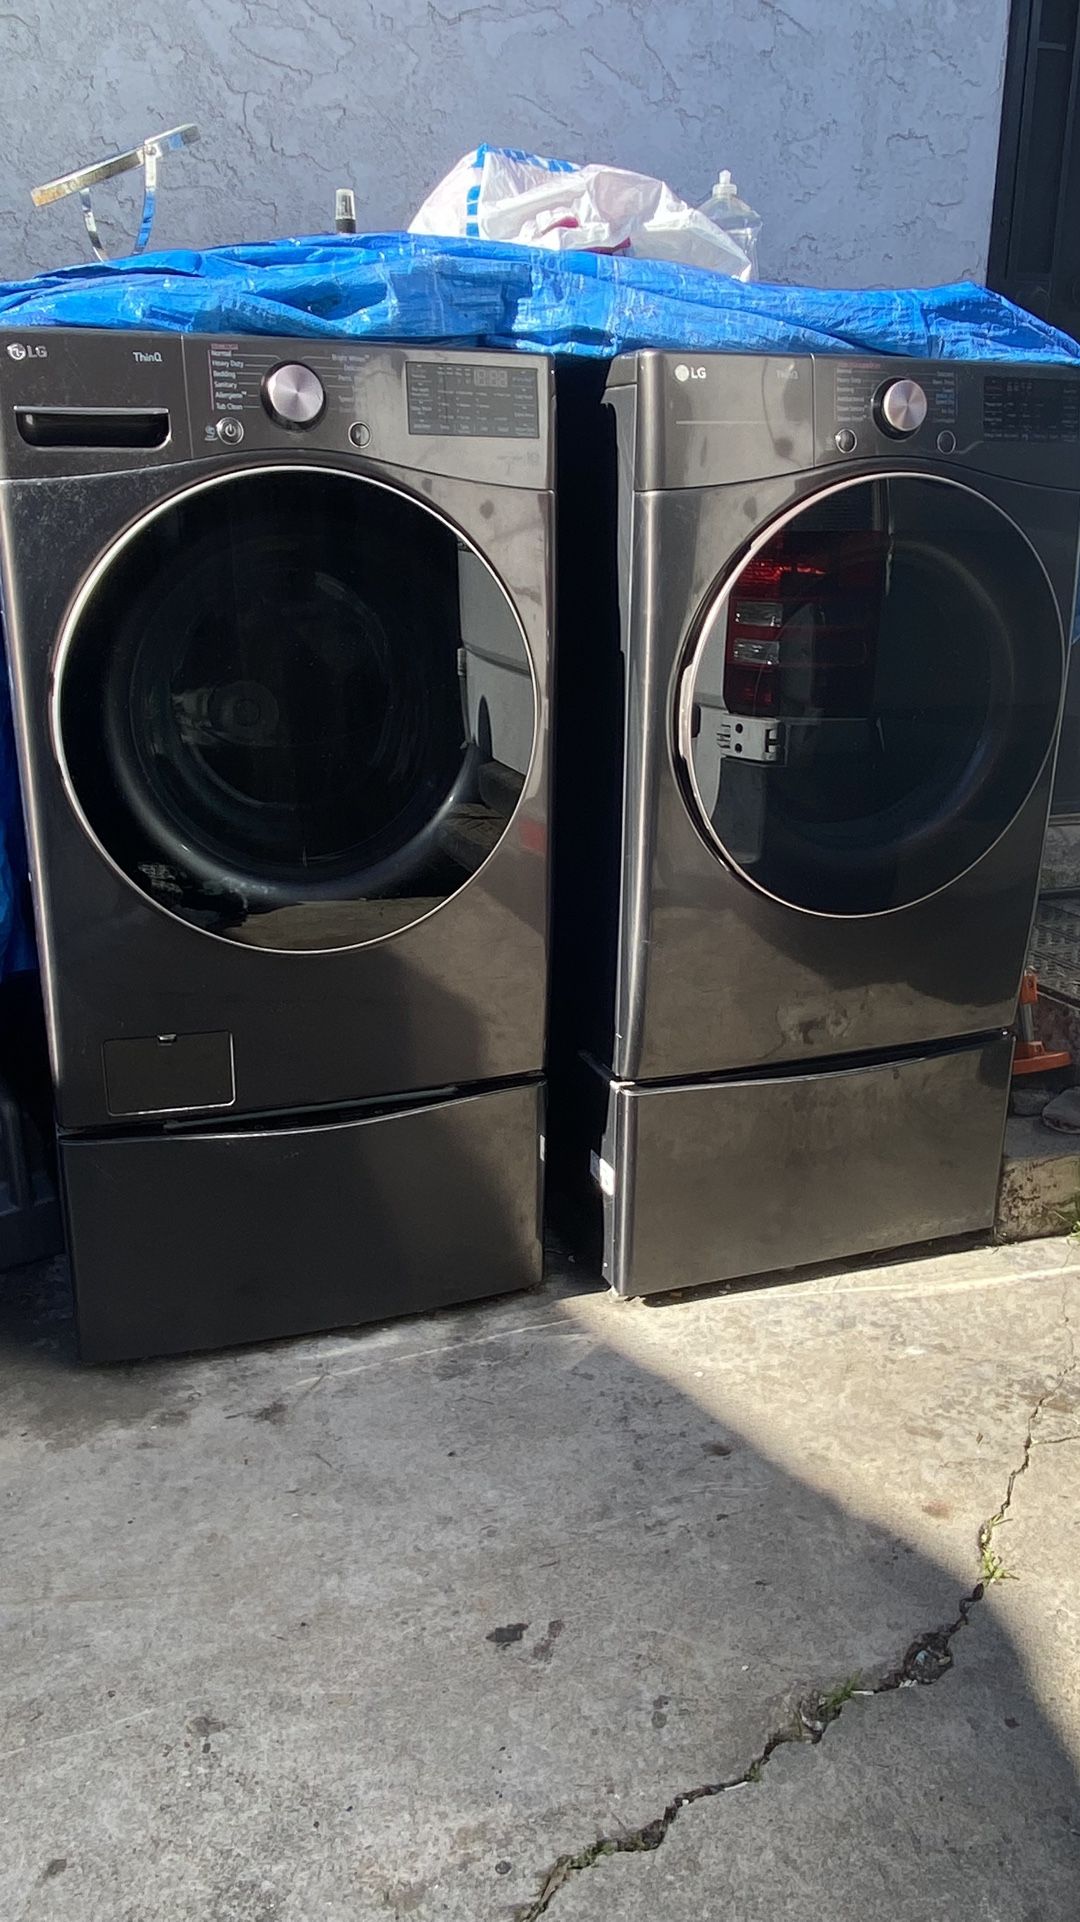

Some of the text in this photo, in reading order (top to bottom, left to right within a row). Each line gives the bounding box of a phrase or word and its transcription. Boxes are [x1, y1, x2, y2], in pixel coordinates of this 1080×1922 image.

[26, 344, 48, 358] LG
[132, 351, 163, 363] ThinQ
[212, 360, 244, 368] Heavy Duty
[213, 370, 236, 379] Bedding
[690, 366, 707, 379] LG
[214, 380, 238, 389] Sanitary
